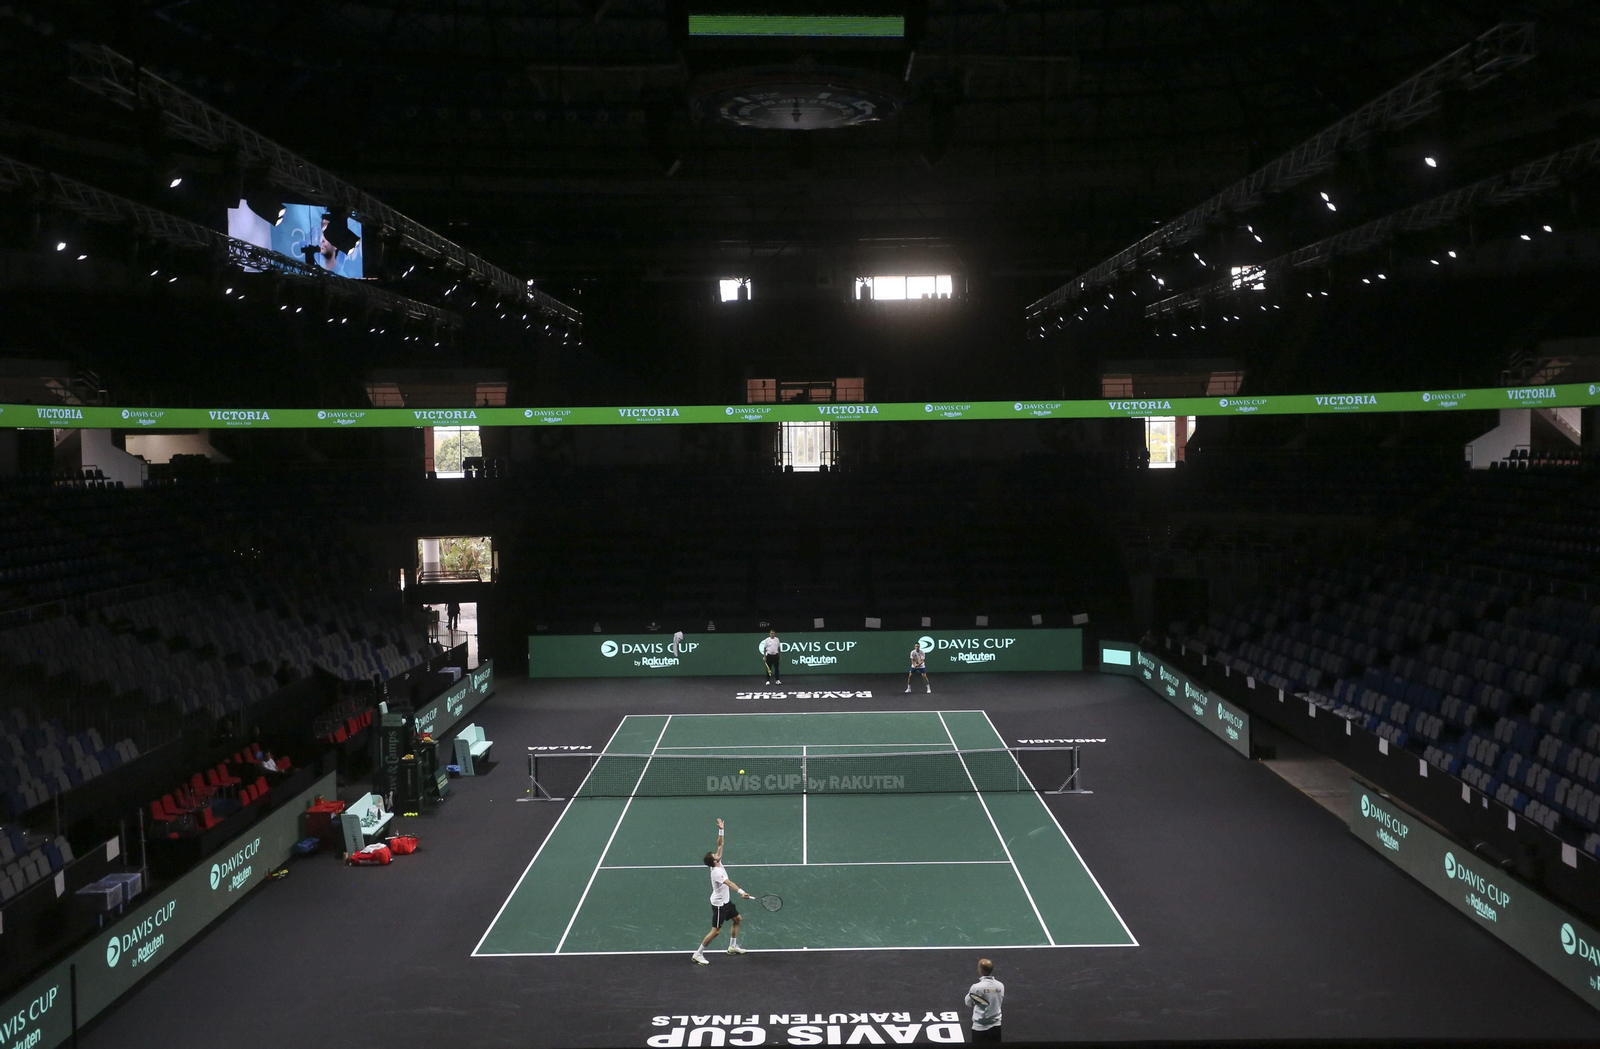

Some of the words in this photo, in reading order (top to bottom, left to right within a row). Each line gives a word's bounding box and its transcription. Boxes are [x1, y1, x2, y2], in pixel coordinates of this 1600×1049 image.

[1507, 388, 1556, 399] VICTORIA
[1108, 401, 1172, 410] VICTORIA
[1316, 395, 1378, 405] VICTORIA
[37, 408, 83, 419] VICTORIA
[209, 411, 270, 420] VICTORIA
[414, 410, 477, 419] VICTORIA
[618, 408, 680, 417] VICTORIA
[818, 406, 879, 414] VICTORIA
[622, 644, 662, 654] DAVIS
[780, 642, 822, 652] DAVIS
[825, 641, 857, 651] CUP
[938, 639, 980, 649] DAVIS
[984, 638, 1015, 648] CUP
[642, 657, 679, 668] Rakuten
[800, 655, 837, 666] Rakuten
[958, 652, 995, 663] Rakuten
[707, 775, 760, 791] DAVIS
[765, 774, 800, 790] CUP
[808, 778, 826, 791] by
[829, 775, 904, 790] RAKUTEN
[1371, 804, 1390, 828] DAVIS
[1392, 819, 1409, 838] CUP
[1380, 828, 1399, 851] Rakuten
[222, 850, 243, 878] DAVIS
[245, 837, 260, 860] CUP
[232, 866, 252, 889] Rakuten
[1458, 864, 1485, 894] DAVIS
[1488, 884, 1510, 908] CUP
[1471, 894, 1496, 922] Rakuten
[122, 916, 153, 952] DAVIS
[155, 900, 176, 926] CUP
[138, 934, 164, 962] Rakuten
[0, 1010, 26, 1044] AVIS
[29, 985, 58, 1020] CUP
[651, 1014, 759, 1026] FINALS
[770, 1012, 911, 1024] RAKUTEN
[922, 1011, 960, 1022] BY
[646, 1026, 766, 1048] CUP
[787, 1023, 965, 1045] DAVIS
